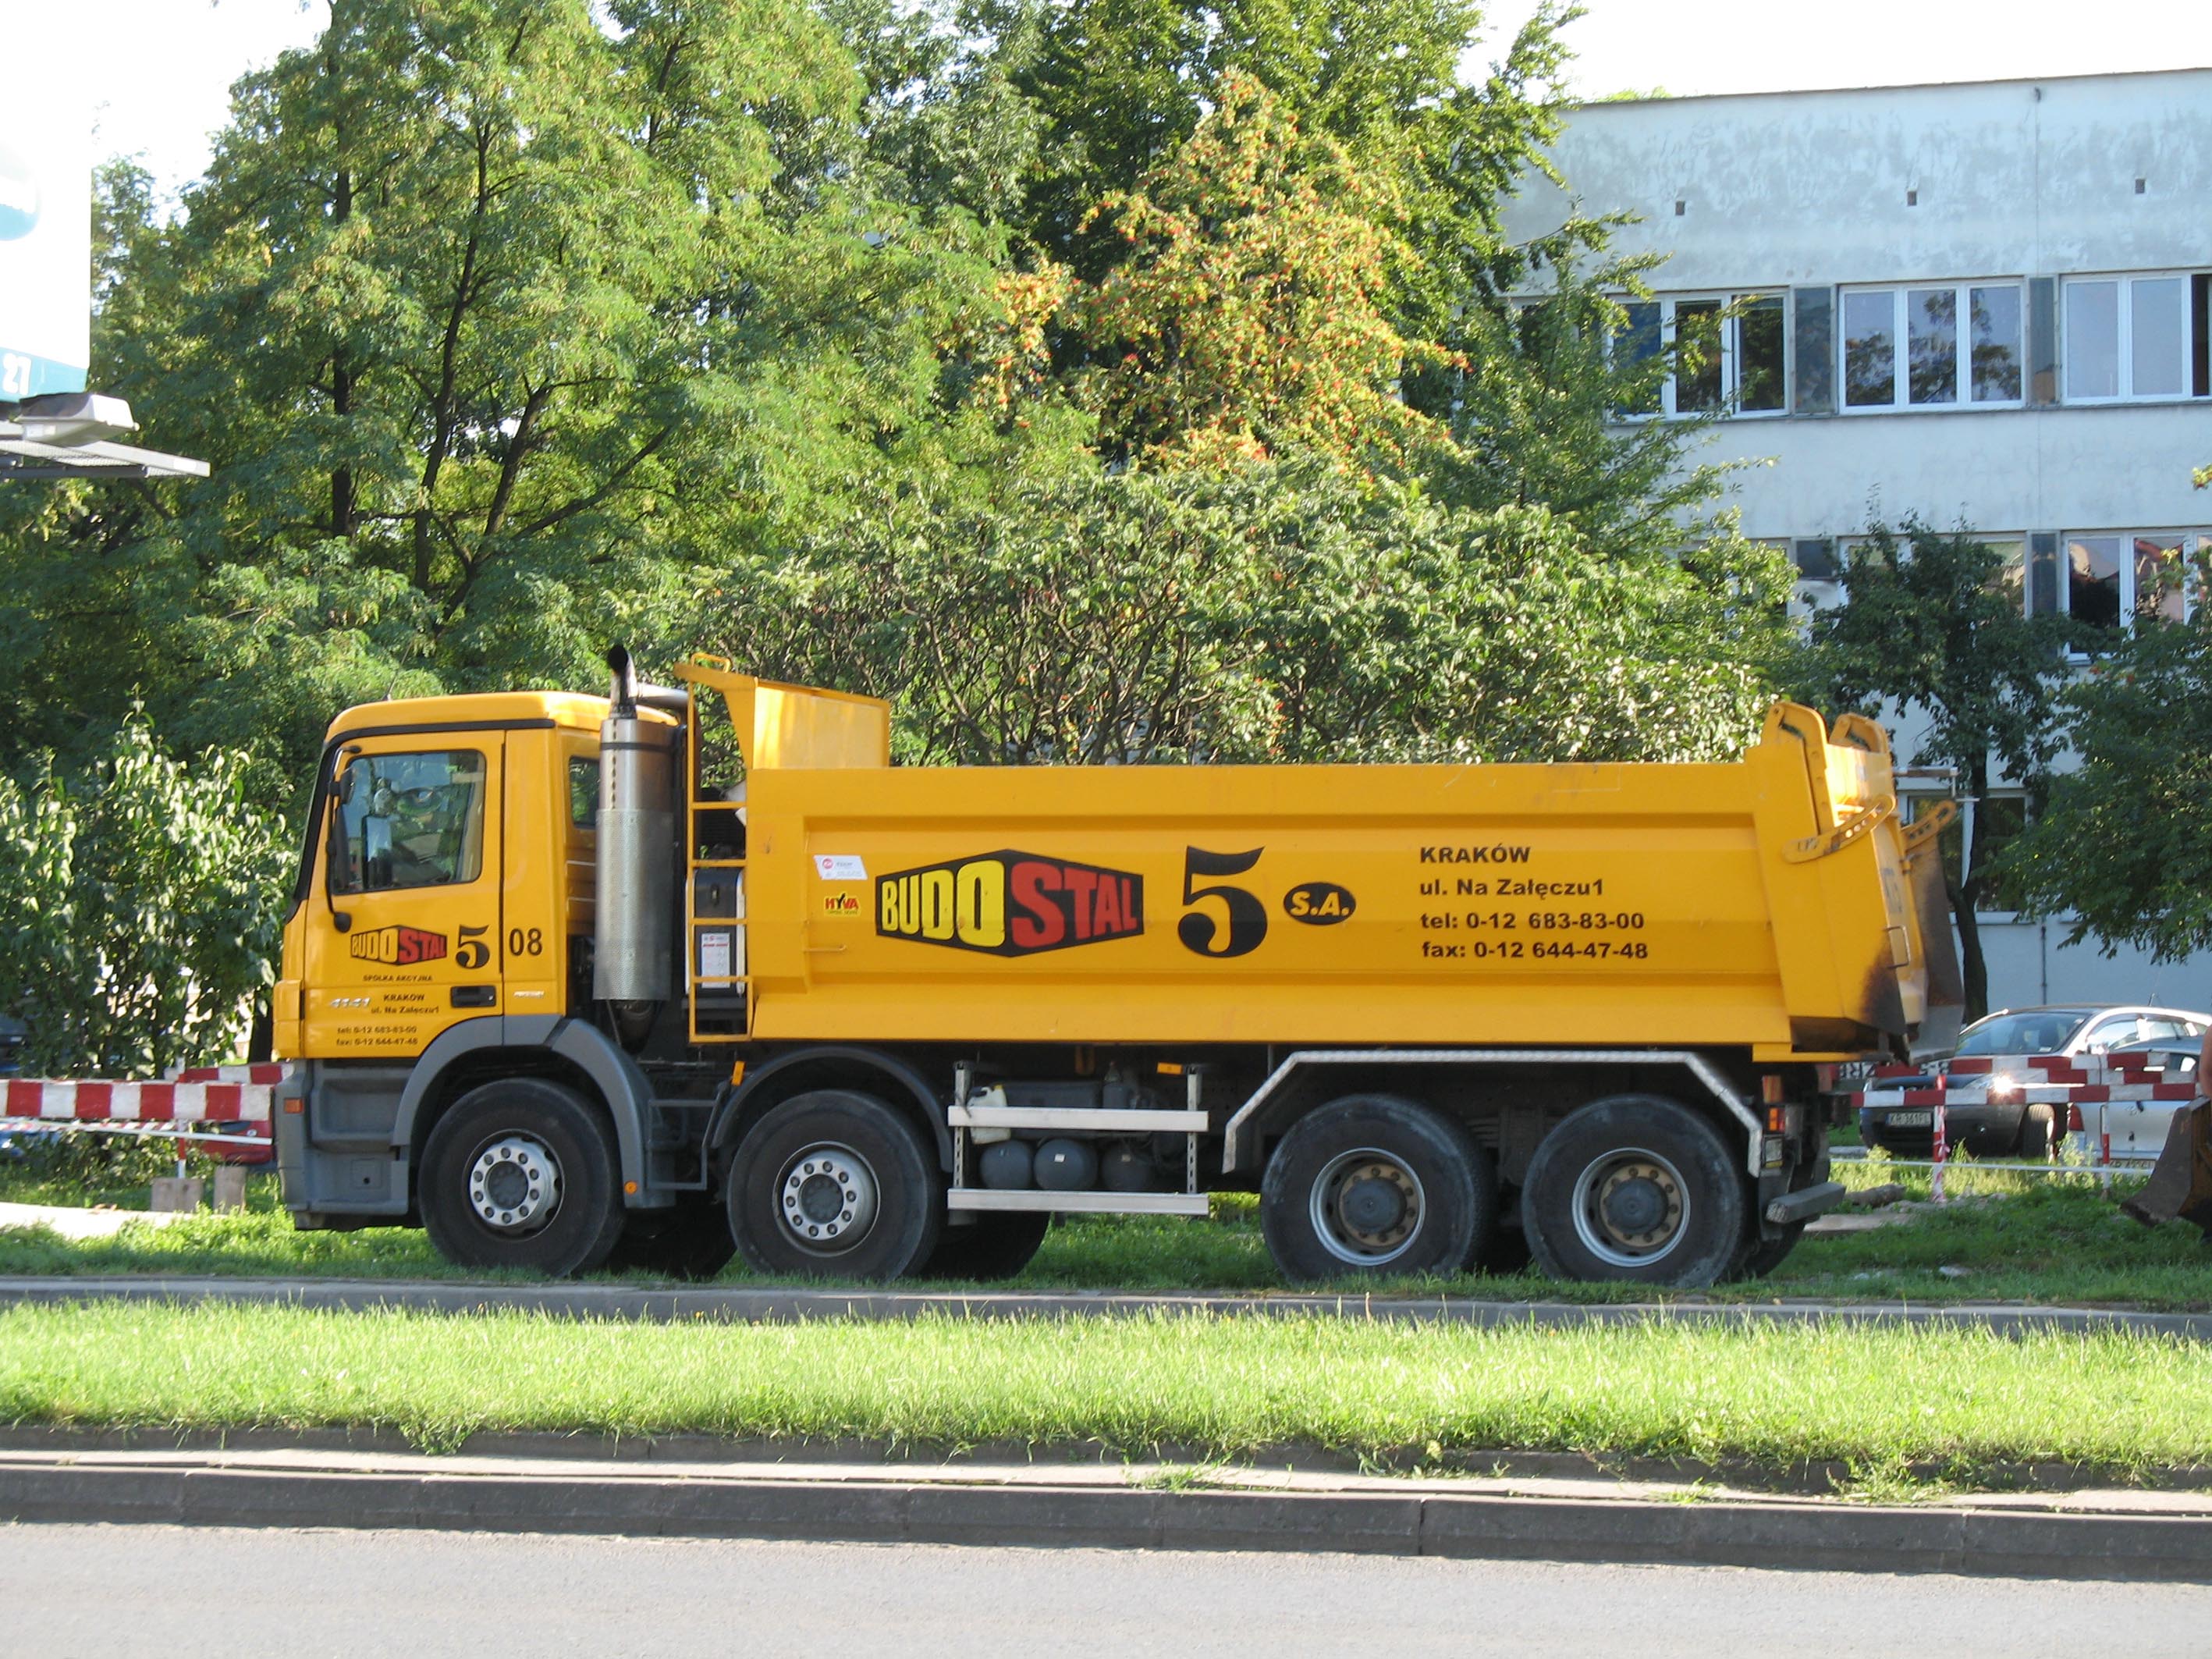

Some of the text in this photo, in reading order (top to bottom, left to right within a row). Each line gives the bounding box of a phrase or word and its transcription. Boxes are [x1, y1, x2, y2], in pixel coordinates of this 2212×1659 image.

[1419, 844, 1531, 863] KRAKÓW
[1420, 879, 1447, 896] ul.
[1458, 879, 1488, 895] Na
[825, 893, 858, 909] HYVA
[1177, 846, 1268, 957] 5
[1290, 890, 1351, 916] S.A.
[1422, 913, 1645, 929] tel: 0-12 683-83-00
[456, 925, 490, 968] 5
[510, 929, 543, 956] 08
[1422, 942, 1648, 959] fax: 0-12 644-47-48
